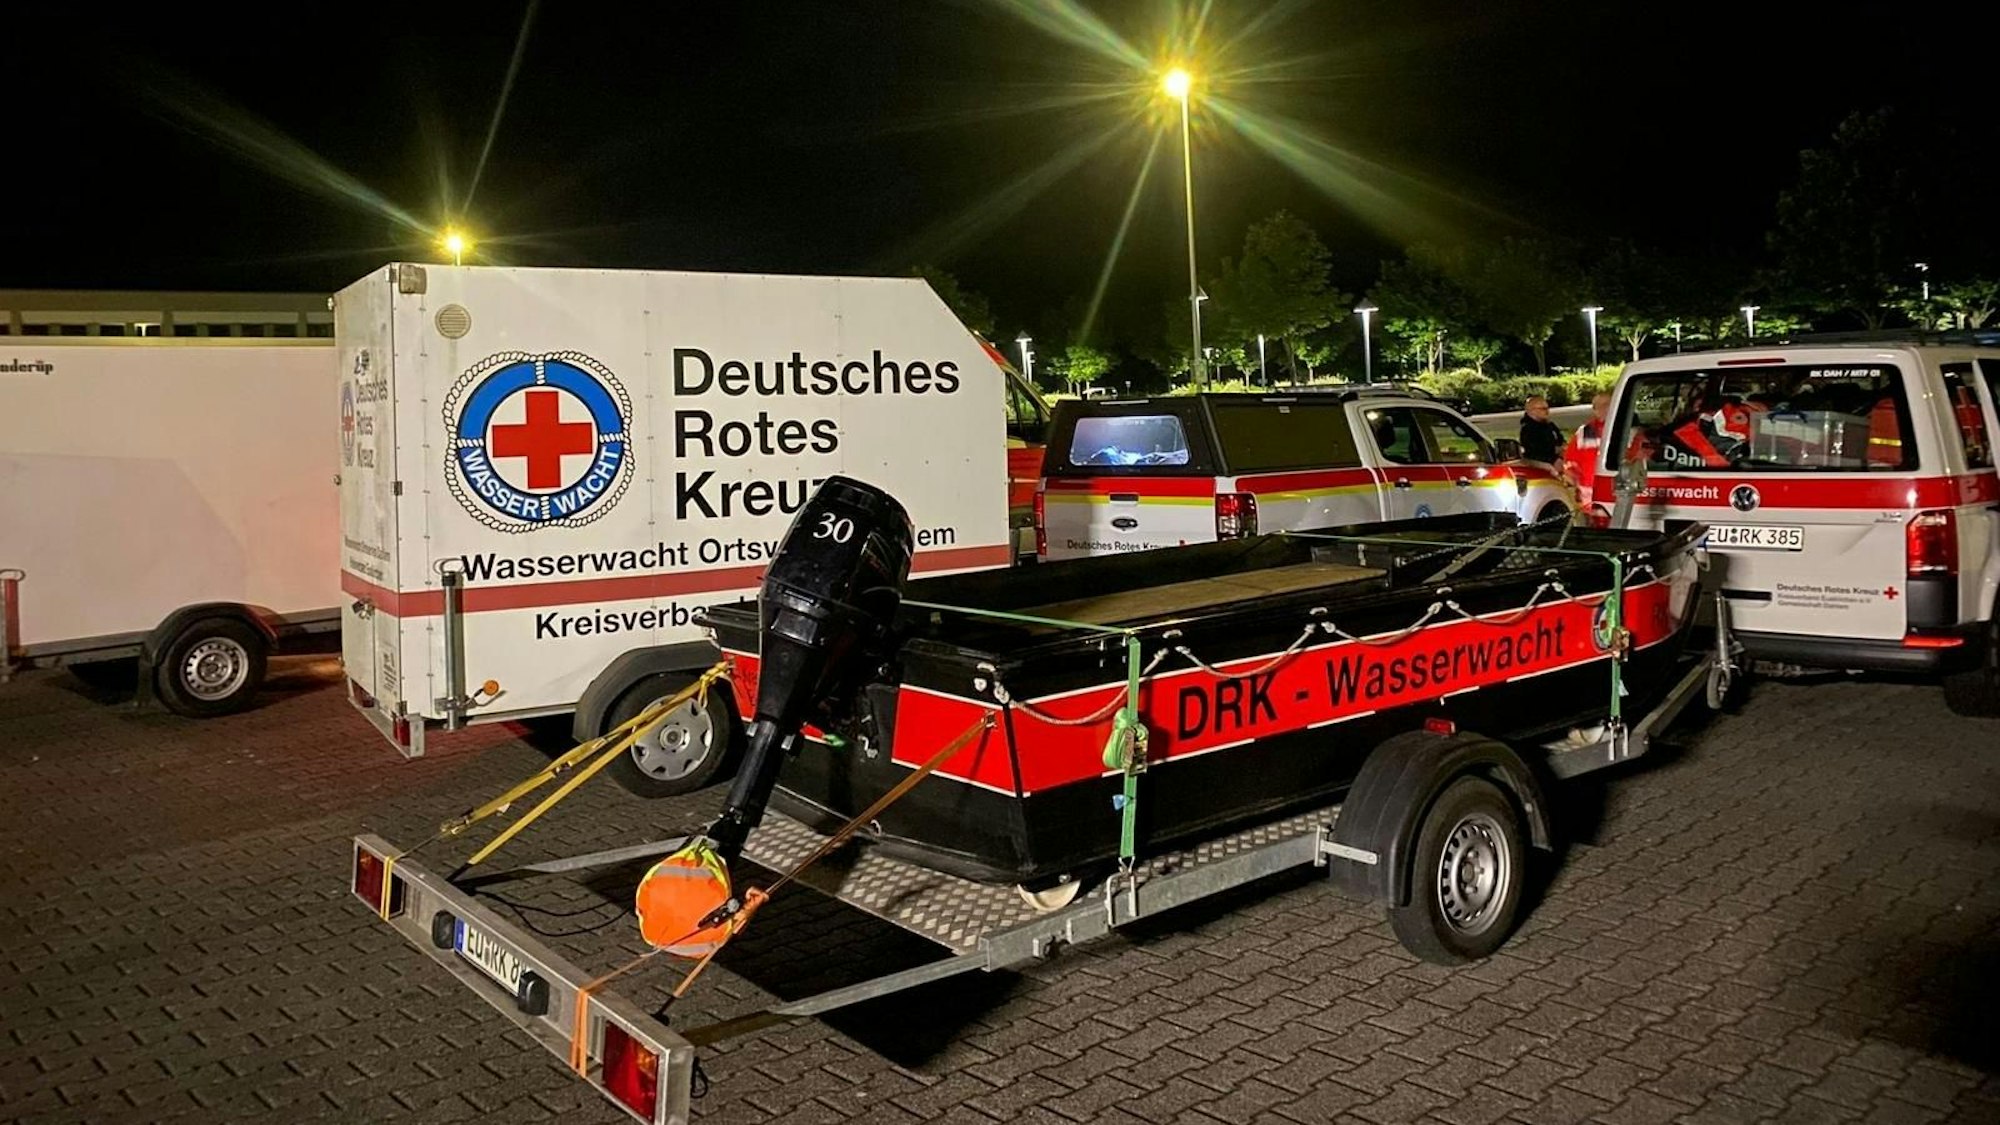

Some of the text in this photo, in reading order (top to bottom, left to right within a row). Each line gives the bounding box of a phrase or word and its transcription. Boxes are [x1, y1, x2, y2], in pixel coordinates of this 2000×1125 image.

[673, 348, 960, 396] Deutsches
[674, 409, 839, 459] Rotes
[463, 446, 619, 518] WASSER WACHT
[676, 470, 826, 521] Kreu
[1636, 485, 1720, 500] sserwacht
[812, 511, 855, 544] 30
[1066, 538, 1113, 551] Deutsches
[1740, 529, 1762, 544] RK
[1767, 530, 1800, 545] 385
[461, 541, 689, 581] Wasserwacht
[699, 538, 780, 565] Ortsv
[1776, 583, 1822, 594] Deutsches
[1177, 671, 1279, 742] DRK
[1326, 616, 1566, 707] Wasserwacht
